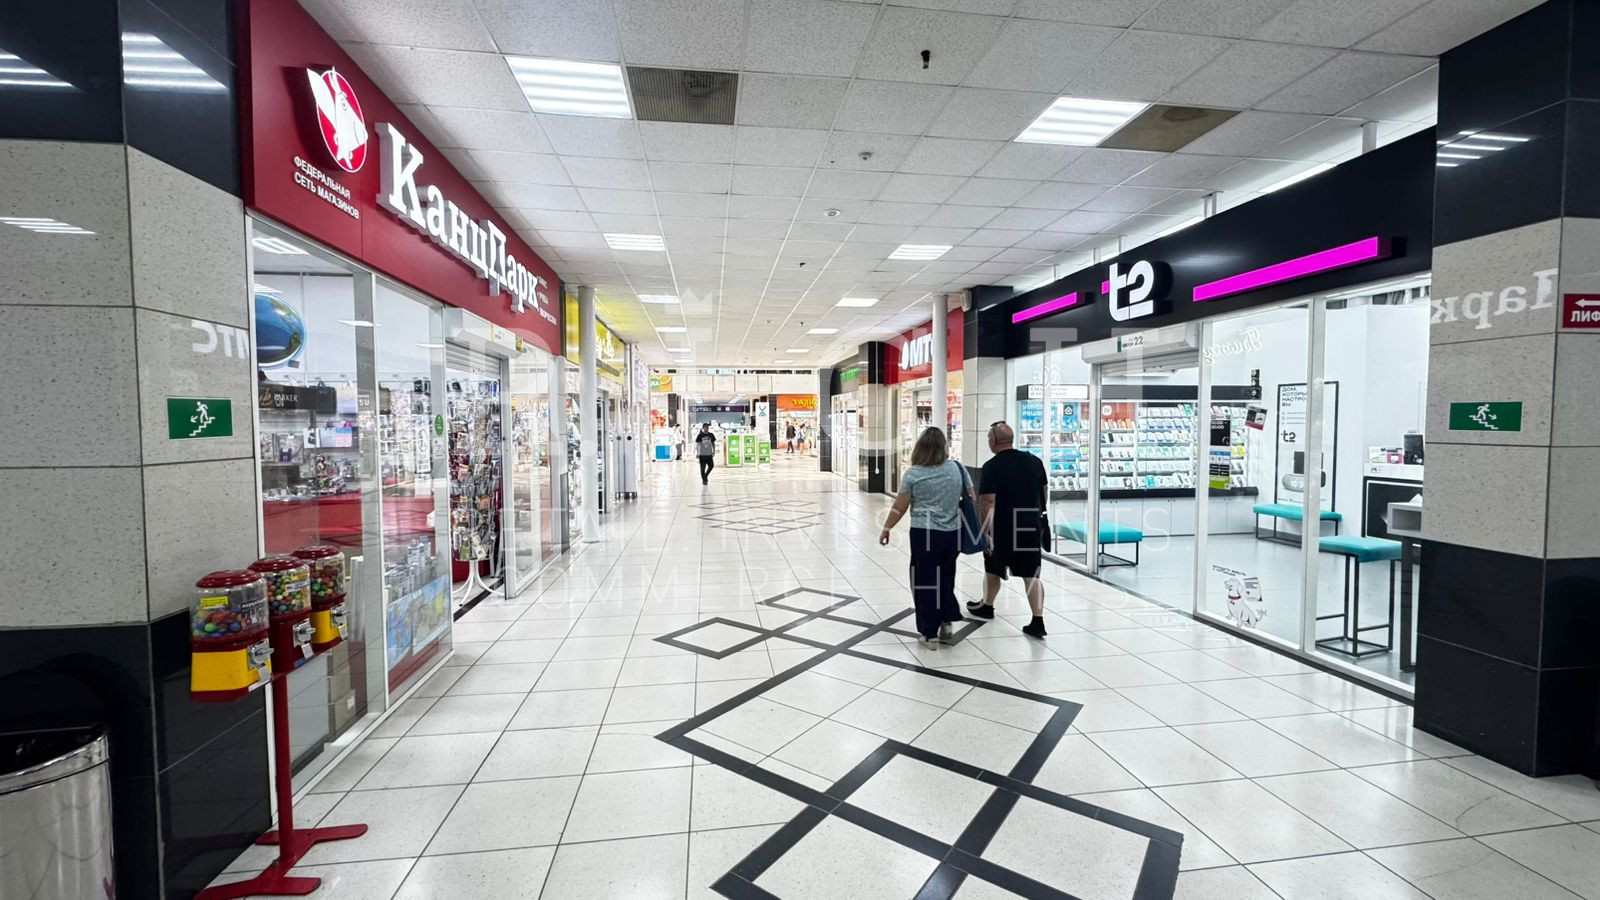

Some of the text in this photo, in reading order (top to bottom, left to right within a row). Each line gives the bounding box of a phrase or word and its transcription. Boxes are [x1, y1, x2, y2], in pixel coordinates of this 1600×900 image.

[293, 156, 351, 200] ФЕДЕРАЛЬНАЯ
[294, 171, 360, 219] СЕТЬ МАГАЗИНОВ
[1108, 260, 1155, 322] t2
[910, 333, 934, 368] МТ
